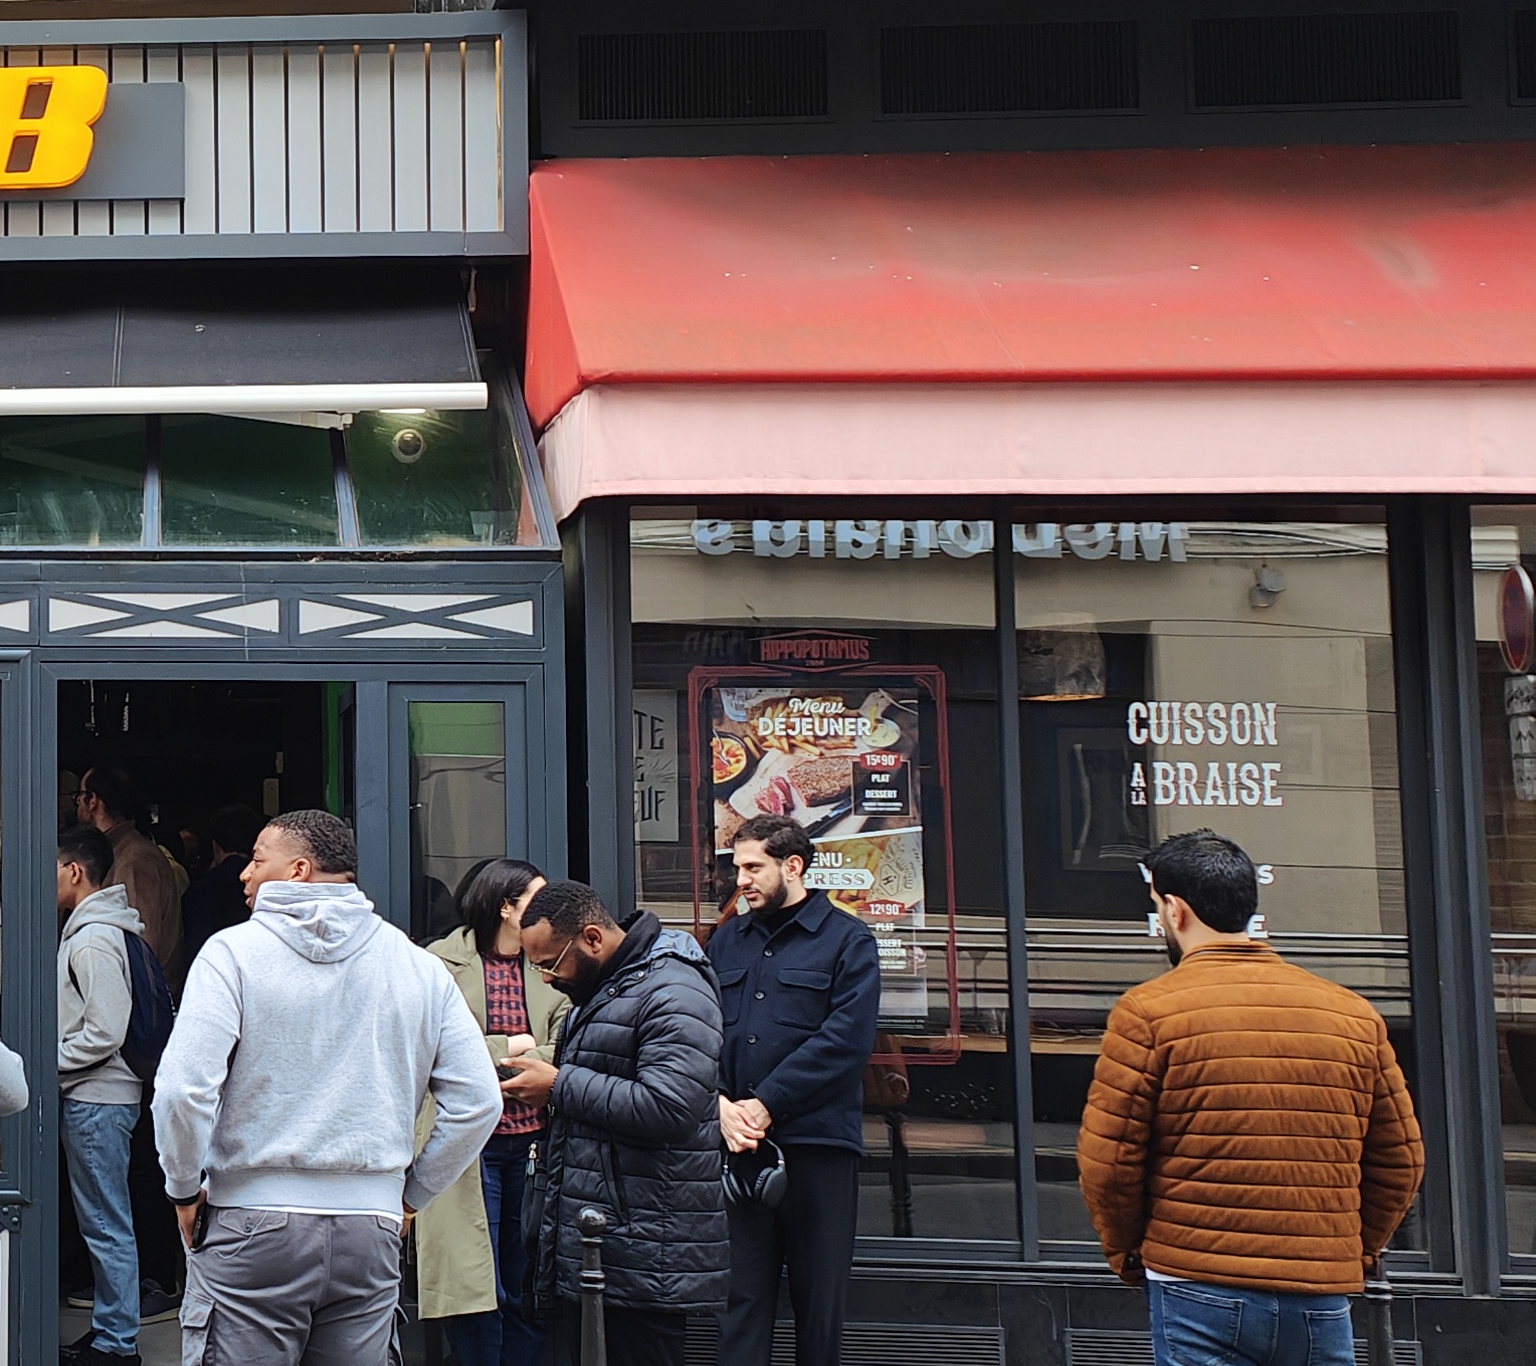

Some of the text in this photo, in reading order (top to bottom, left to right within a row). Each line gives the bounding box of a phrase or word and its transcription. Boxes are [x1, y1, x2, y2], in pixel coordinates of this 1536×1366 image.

[789, 697, 846, 716] Menu
[758, 713, 872, 737] DÉJEUNER
[1127, 701, 1278, 745] CUISSON
[1153, 762, 1283, 806] BRAISE
[810, 852, 843, 868] ENU
